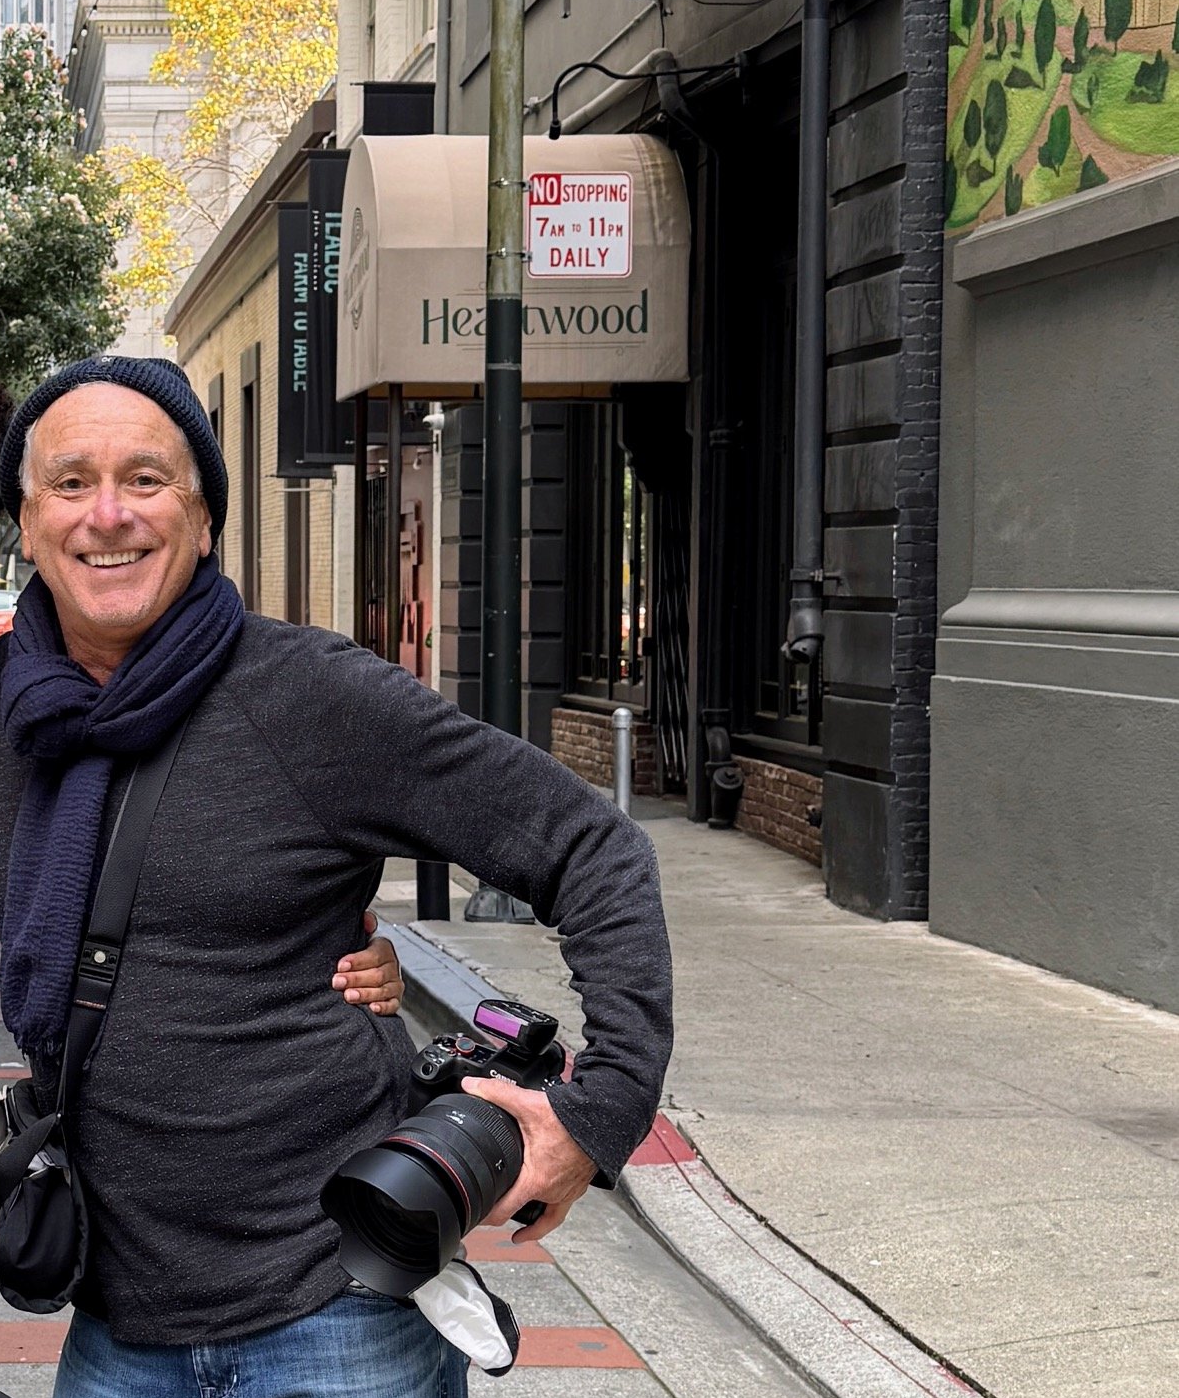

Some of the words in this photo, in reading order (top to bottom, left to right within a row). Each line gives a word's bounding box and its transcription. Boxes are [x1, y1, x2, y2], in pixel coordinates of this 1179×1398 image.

[533, 177, 558, 203] NO
[562, 184, 627, 202] STOPPING
[572, 224, 581, 233] TO
[550, 247, 609, 267] DAILY
[422, 287, 648, 344] Heatwood
